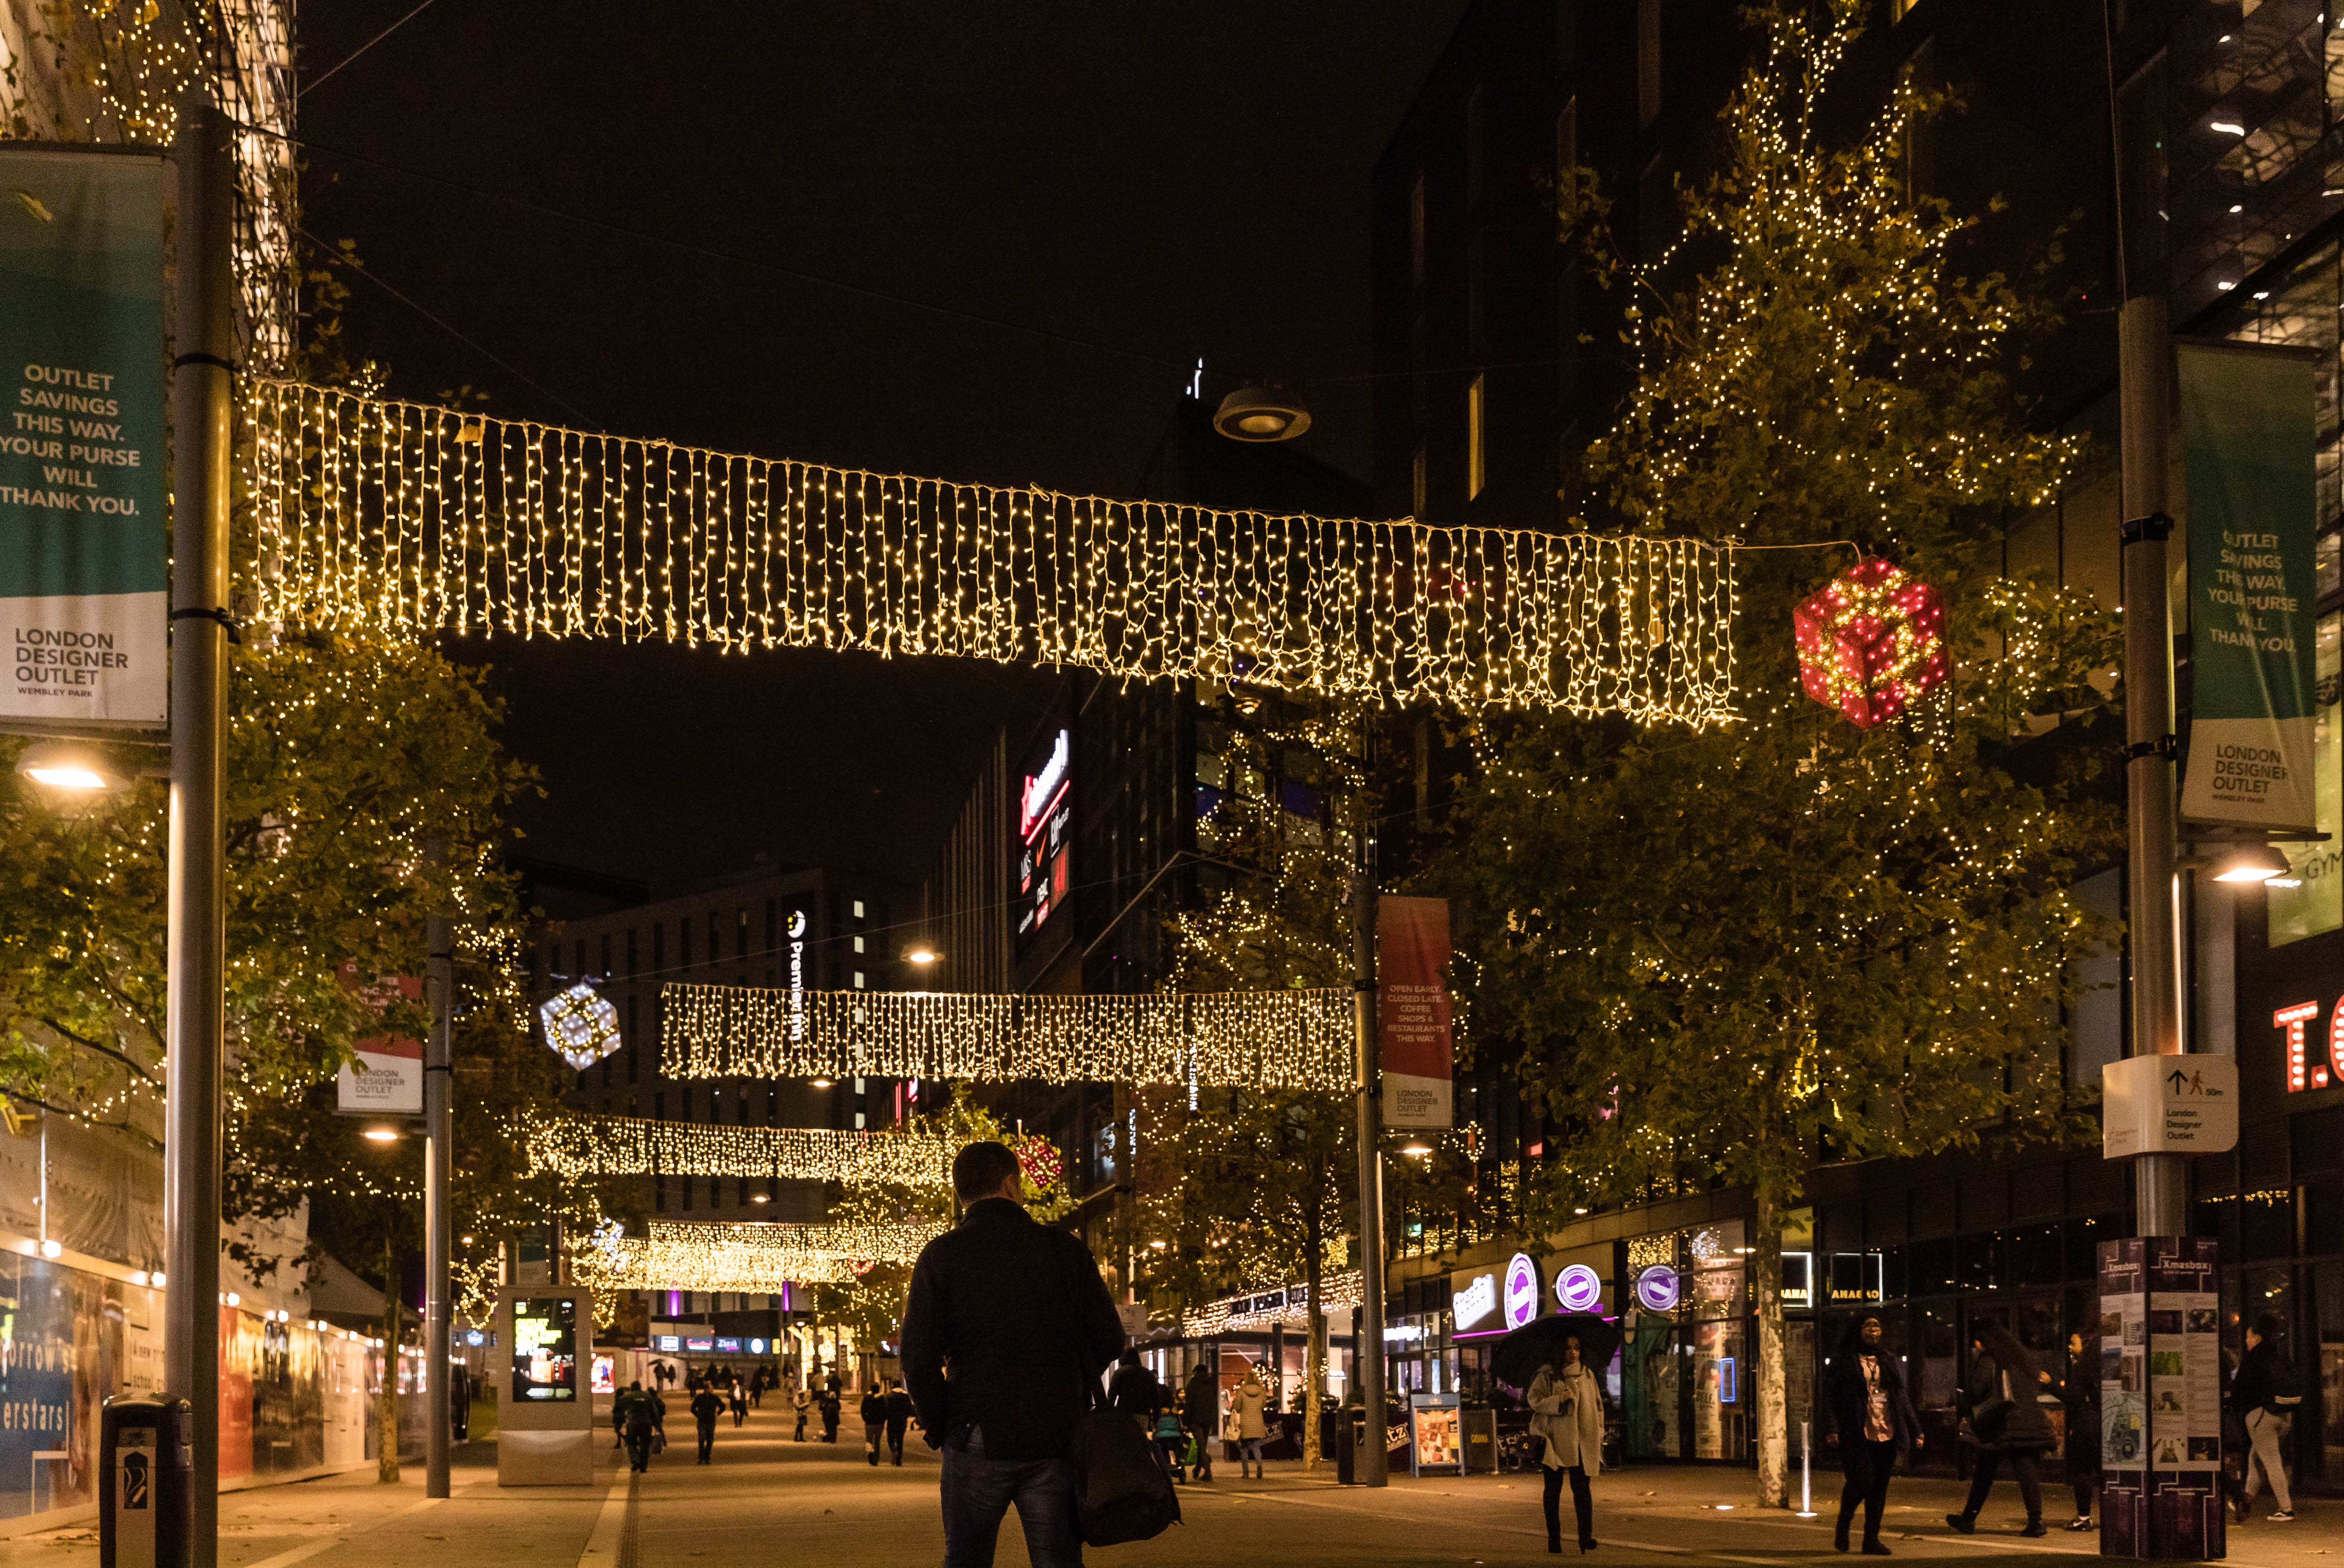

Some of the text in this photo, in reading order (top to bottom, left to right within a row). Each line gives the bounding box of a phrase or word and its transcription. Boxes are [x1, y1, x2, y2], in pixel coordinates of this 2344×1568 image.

[25, 364, 114, 391] OUTLET
[20, 388, 119, 416] SAVINGS
[13, 413, 125, 442] THIS WAY.
[0, 436, 141, 467] YOUR PURSE
[43, 465, 98, 488] WILL
[0, 486, 140, 516] THANK YOU.
[2246, 596, 2297, 612] PURSE
[15, 628, 114, 649] LONDON
[2209, 627, 2256, 648] THAN
[16, 647, 128, 668] DESIGNER
[16, 666, 98, 685] OUTLET
[18, 687, 66, 696] WEMBLEY
[2216, 743, 2281, 764] LONDON
[2213, 775, 2271, 794] OUTLET
[791, 941, 804, 1040] Premier Inn
[1388, 1024, 1445, 1033] RESTAURANTS
[2166, 1120, 2202, 1130] Designer
[2166, 1132, 2194, 1140] Outlet
